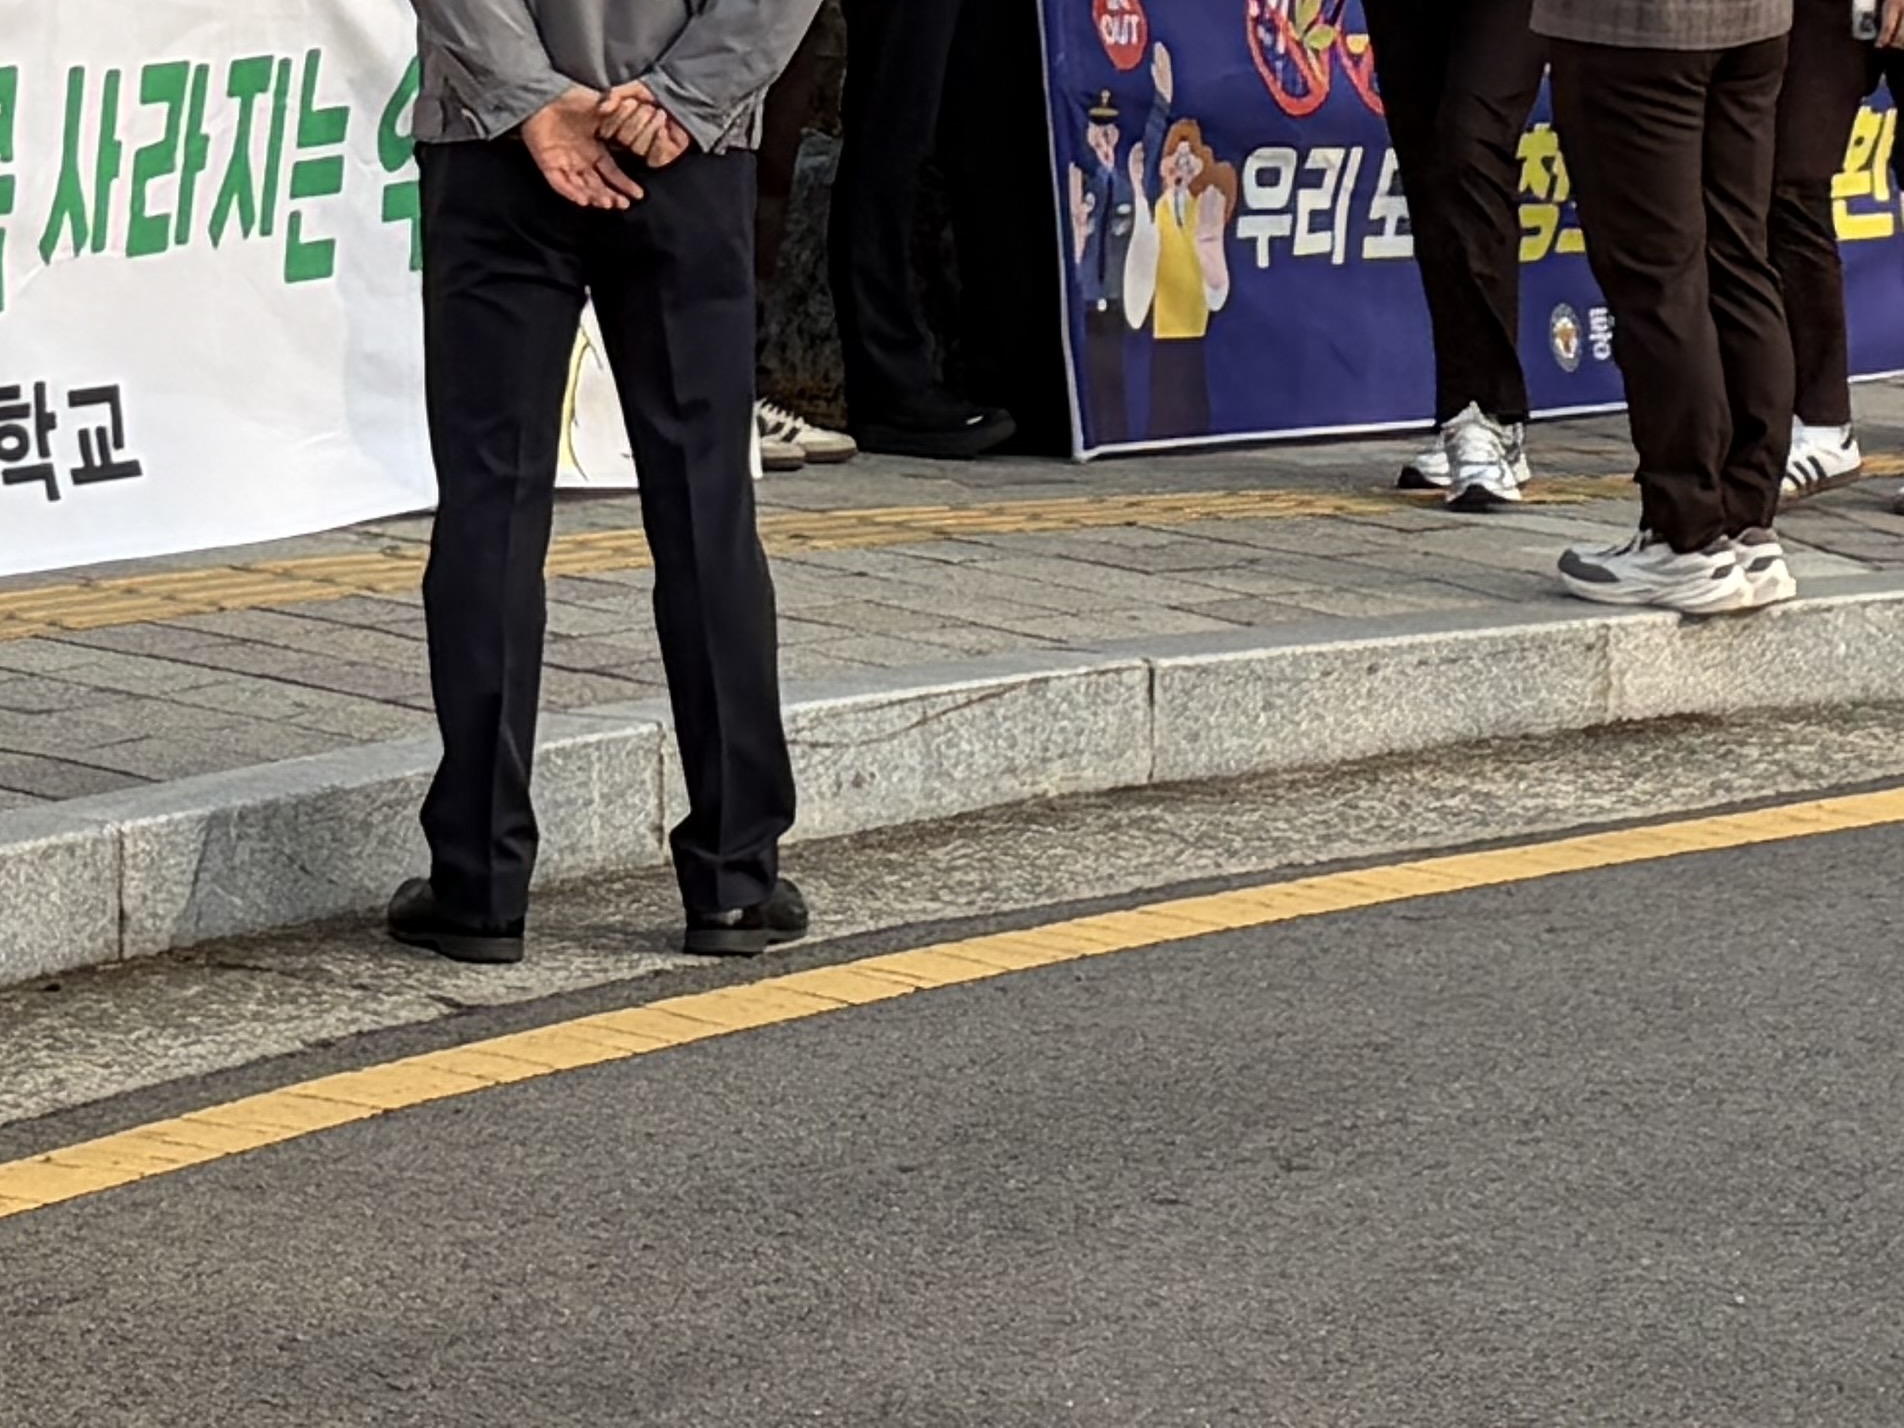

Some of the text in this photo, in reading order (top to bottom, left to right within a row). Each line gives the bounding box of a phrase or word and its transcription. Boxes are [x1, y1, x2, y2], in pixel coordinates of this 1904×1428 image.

[1101, 12, 1140, 46] OUT
[38, 46, 350, 284] 사라지는
[1236, 145, 1364, 269] 우리
